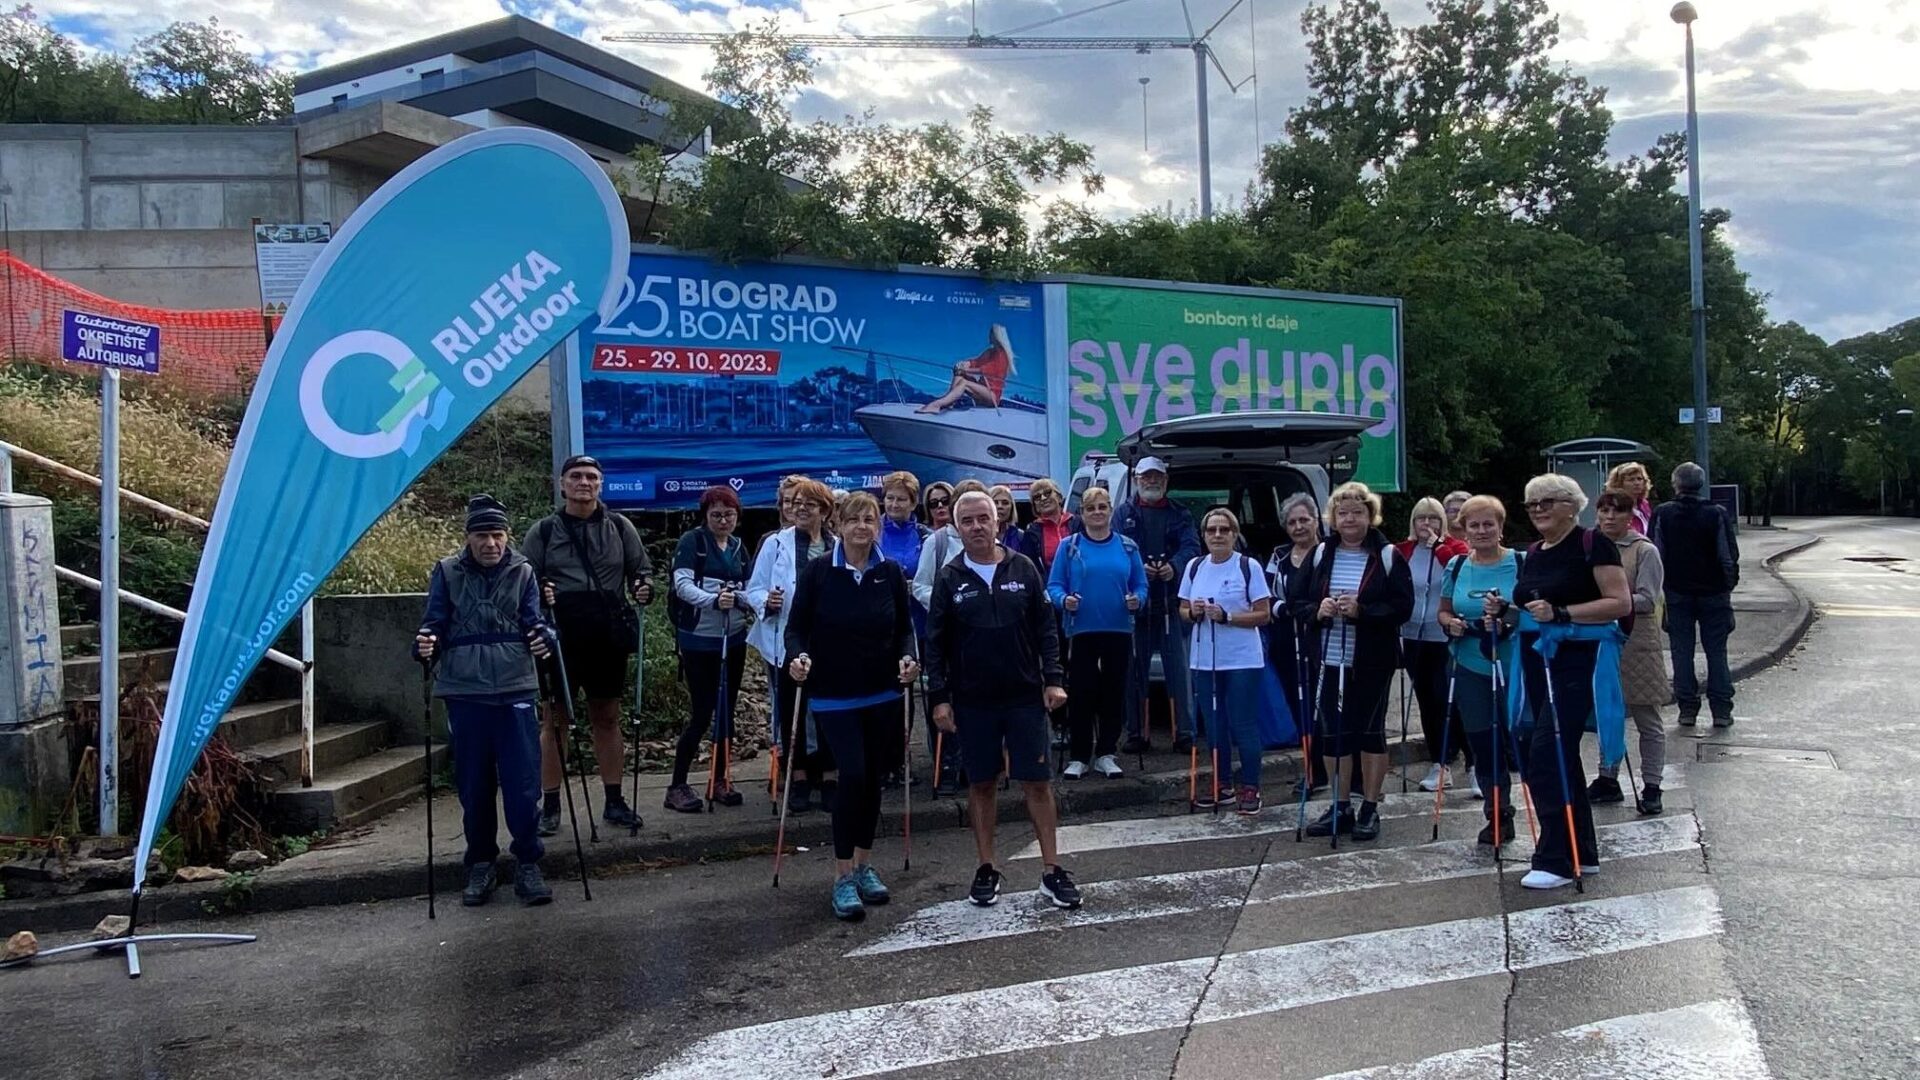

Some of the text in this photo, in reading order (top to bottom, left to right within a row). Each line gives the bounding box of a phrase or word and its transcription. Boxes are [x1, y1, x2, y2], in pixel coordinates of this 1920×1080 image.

[431, 250, 562, 365] RIJEKA
[592, 275, 837, 338] 25. BIOGRAD
[1184, 308, 1299, 334] bonbon ti daje
[77, 327, 146, 350] OKRETIŠTE
[463, 280, 581, 388] Outdoor
[680, 310, 866, 345] BOAT SHOW
[77, 346, 145, 367] AUTOBUSA
[600, 348, 633, 369] 25.
[650, 350, 681, 370] 29.
[686, 352, 714, 371] 10.
[719, 353, 773, 373] 2023.
[1069, 339, 1196, 395] sve
[609, 483, 634, 491] ERSTE
